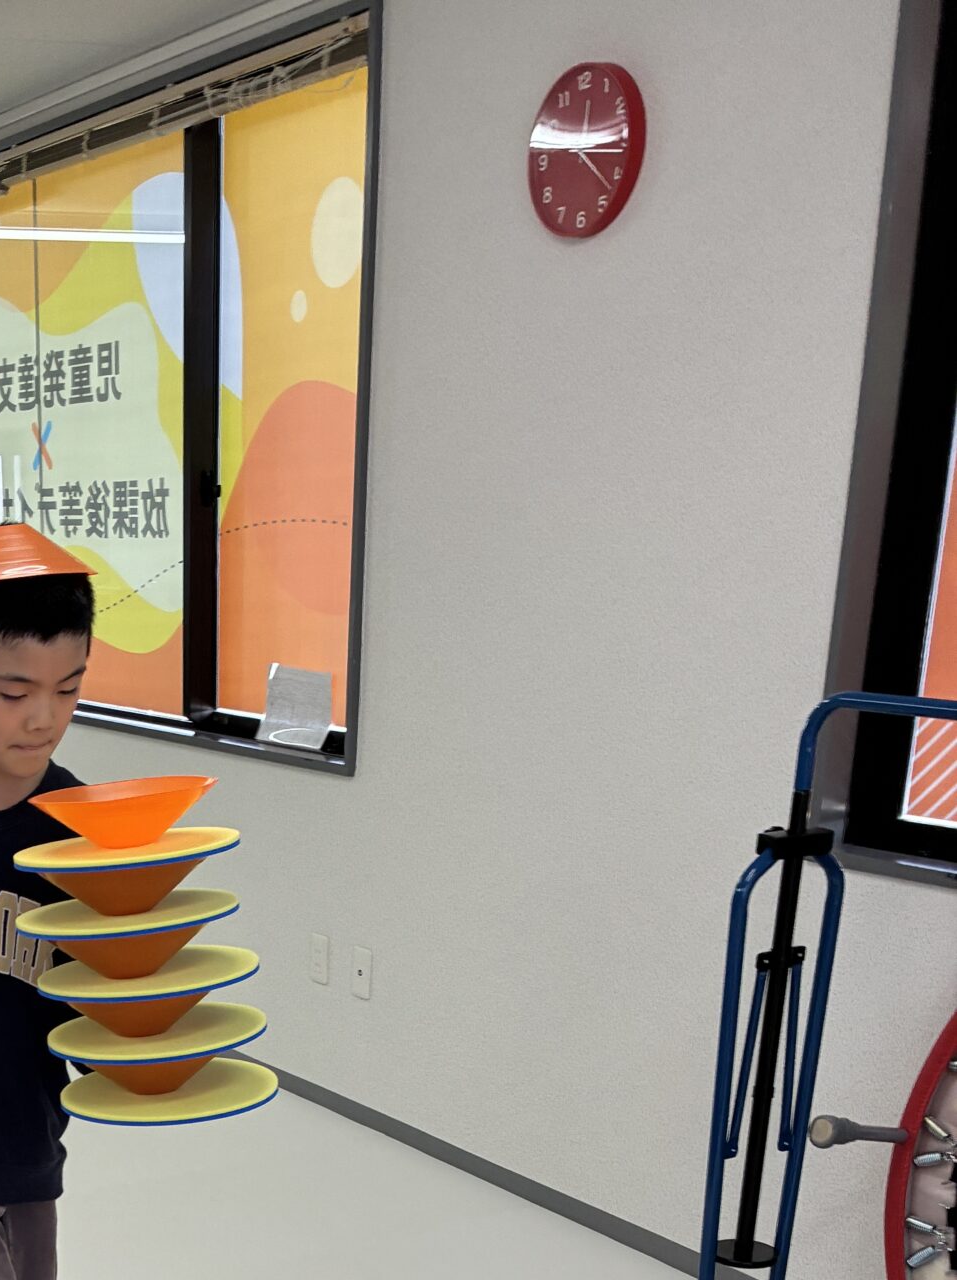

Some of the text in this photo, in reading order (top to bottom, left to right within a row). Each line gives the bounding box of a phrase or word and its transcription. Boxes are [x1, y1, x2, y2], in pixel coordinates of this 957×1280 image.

[577, 71, 592, 91] 12
[603, 78, 610, 93] 1
[558, 91, 570, 108] 11
[615, 96, 626, 115] 2
[538, 154, 548, 171] 9
[543, 187, 552, 203] 8
[597, 195, 608, 213] 5
[556, 206, 566, 224] 7
[576, 211, 586, 228] 6
